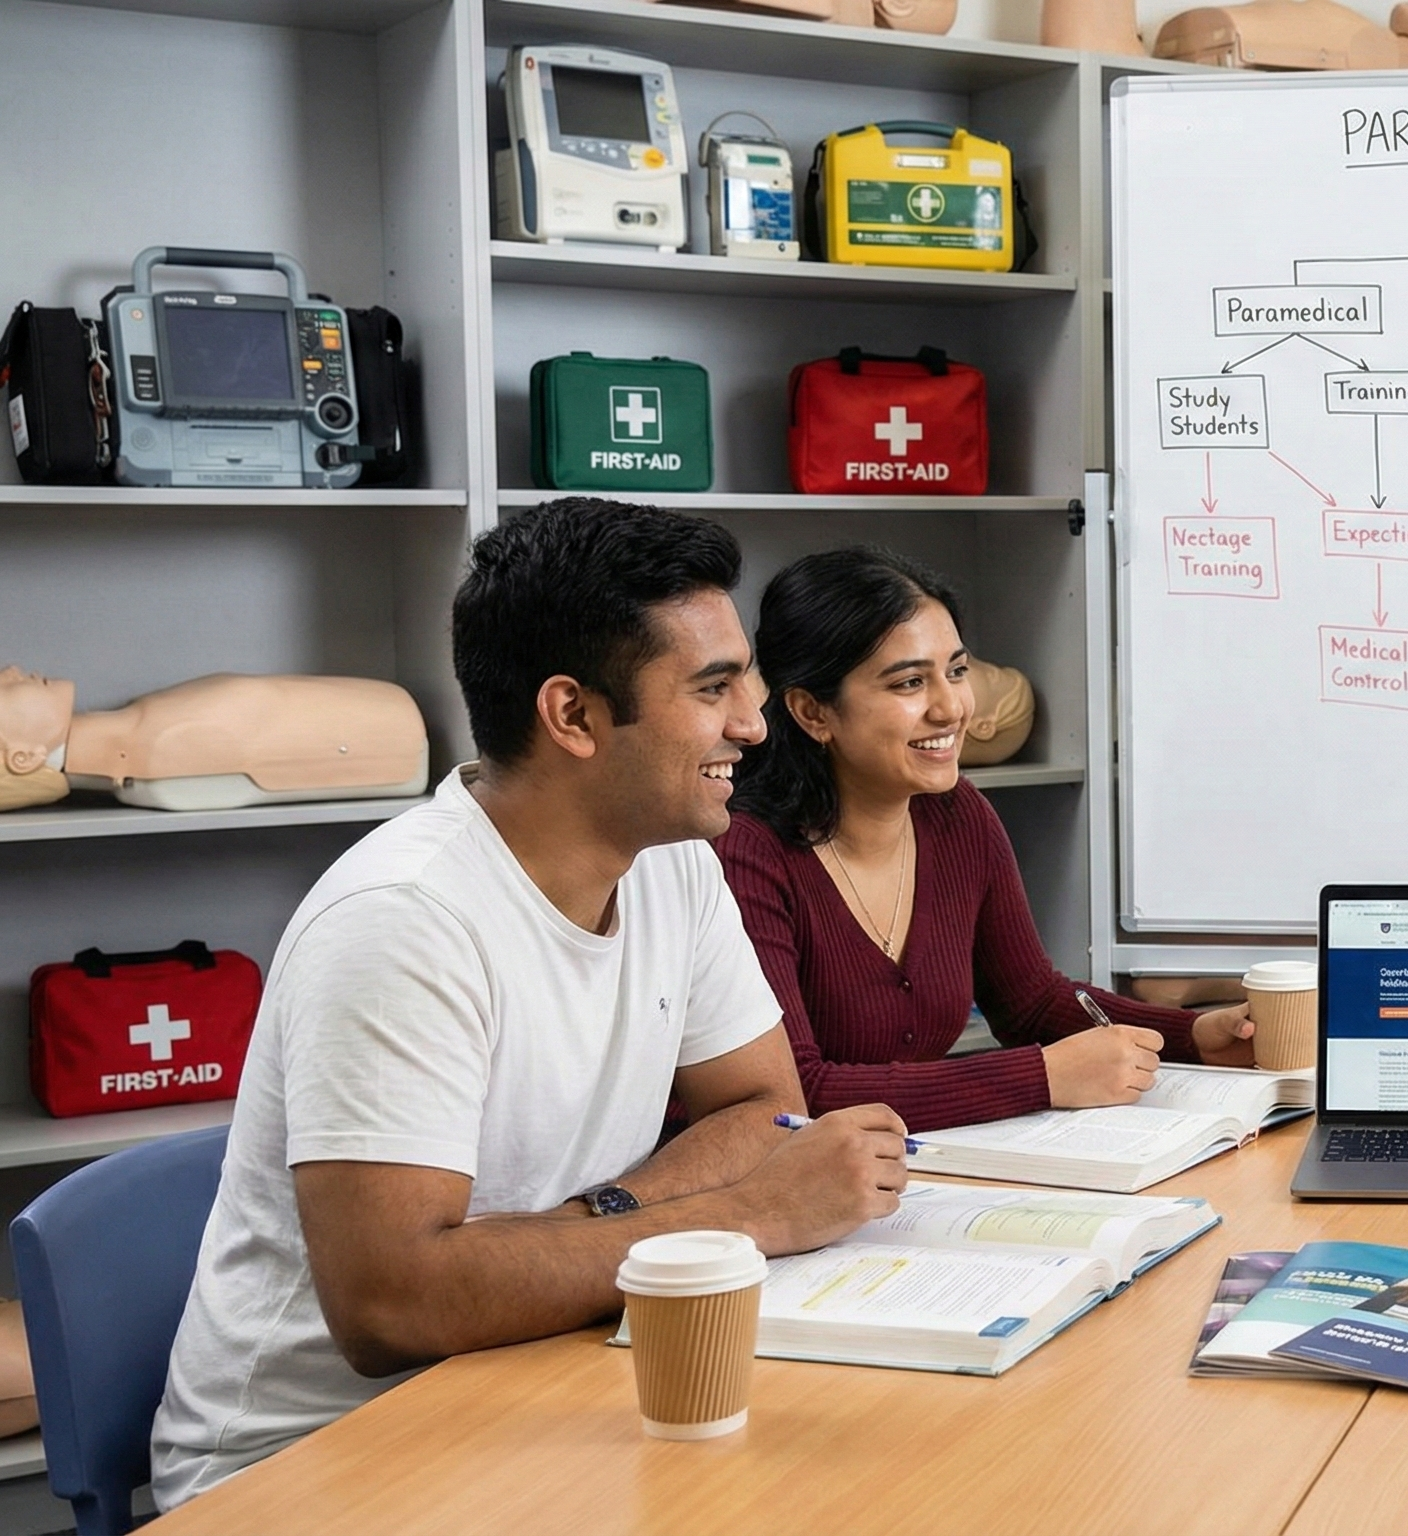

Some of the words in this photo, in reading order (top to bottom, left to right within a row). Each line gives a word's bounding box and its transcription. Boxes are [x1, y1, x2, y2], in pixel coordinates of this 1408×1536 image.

[1227, 295, 1368, 323] Paramedical
[1168, 386, 1231, 419] Study
[1170, 412, 1259, 436] Students
[590, 451, 681, 471] FIRST-AID
[845, 462, 950, 481] FIRST-AID
[1172, 526, 1252, 555] Nectage
[1178, 555, 1263, 590] Training
[1330, 636, 1408, 663] Medical
[101, 1062, 223, 1094] FIRST-AID
